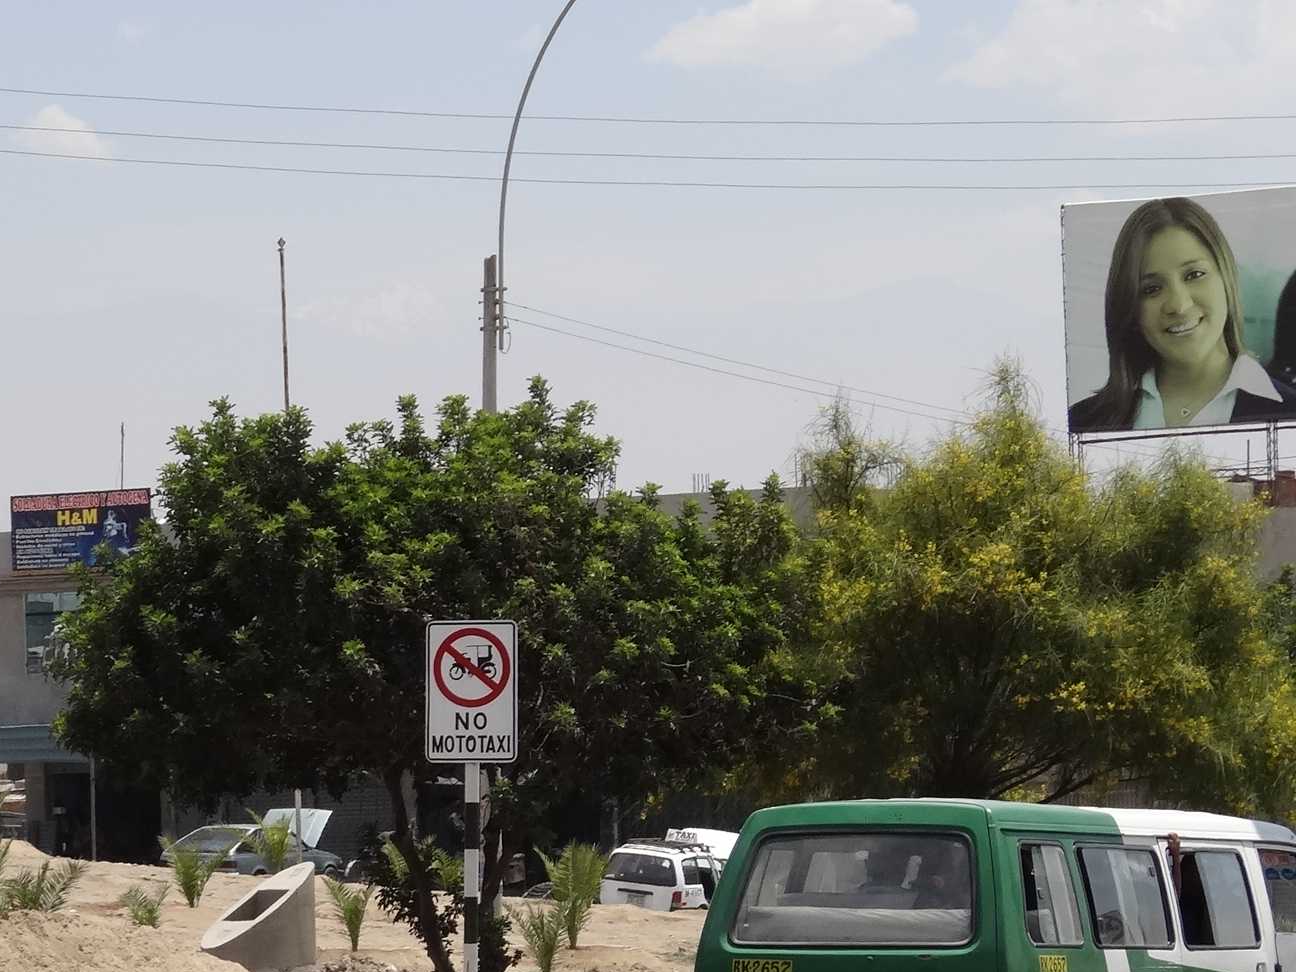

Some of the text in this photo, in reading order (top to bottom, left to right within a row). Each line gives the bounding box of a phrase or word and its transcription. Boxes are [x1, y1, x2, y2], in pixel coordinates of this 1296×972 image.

[57, 508, 97, 526] H&M
[455, 712, 487, 730] NO
[432, 735, 511, 753] MOTOTAXI
[675, 831, 696, 841] TAXI
